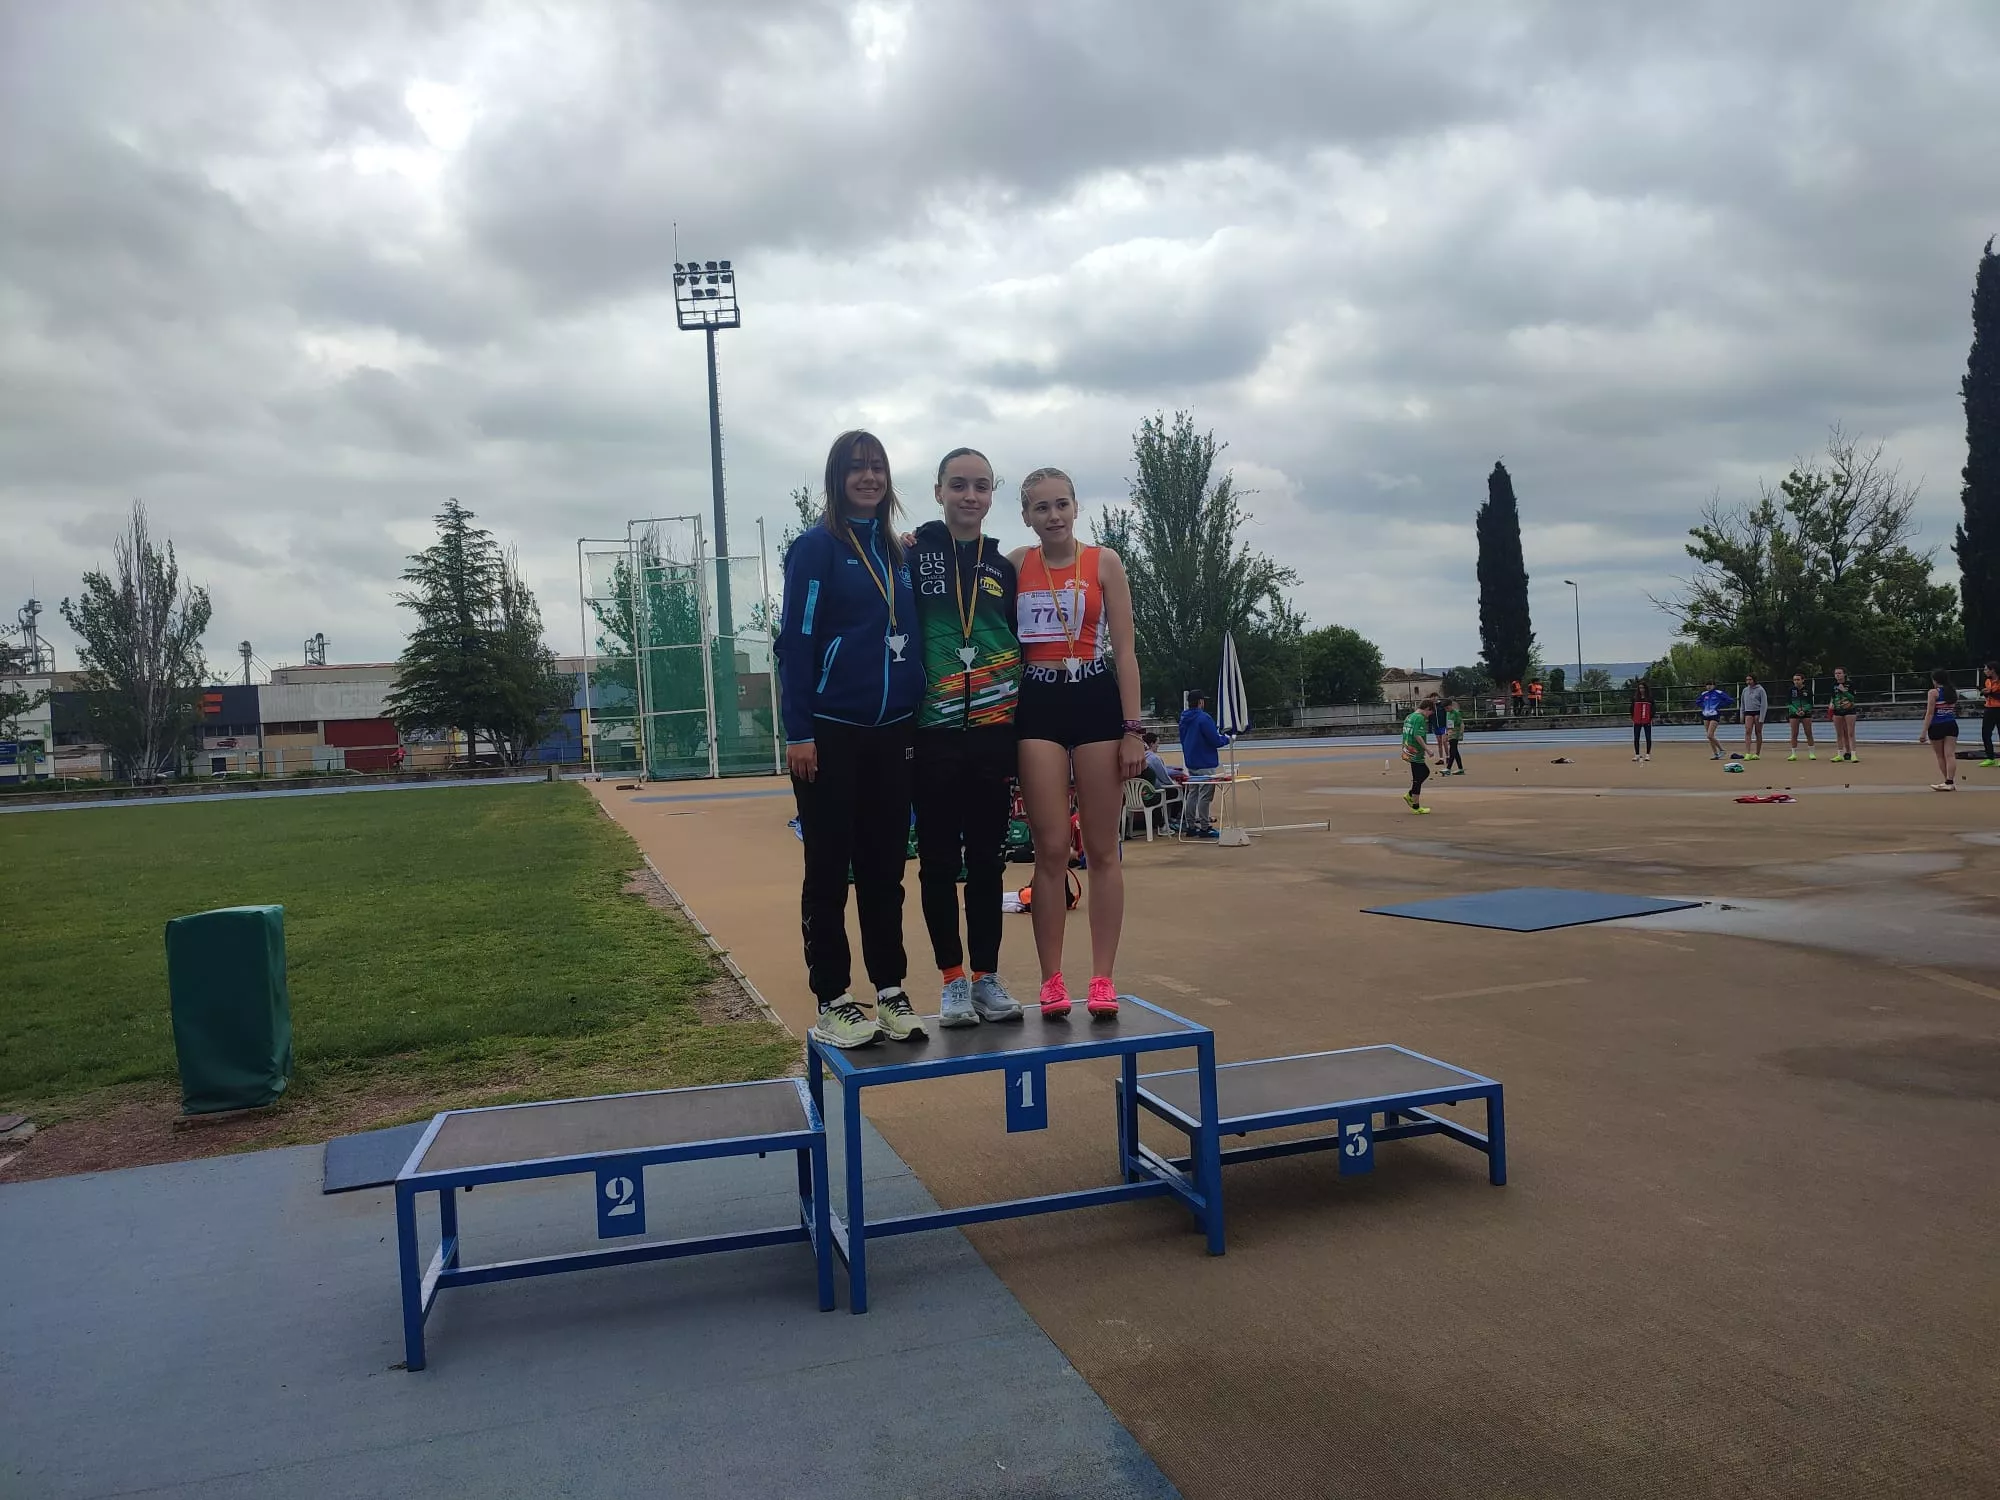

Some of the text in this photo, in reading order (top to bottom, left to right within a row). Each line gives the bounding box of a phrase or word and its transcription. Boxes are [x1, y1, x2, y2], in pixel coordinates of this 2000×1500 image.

[920, 561, 945, 576] es
[920, 580, 947, 595] ca
[1031, 607, 1069, 624] 776
[1024, 665, 1058, 683] PRO
[1016, 1071, 1035, 1108] 1
[1345, 1123, 1368, 1157] 3
[605, 1176, 636, 1217] 2
